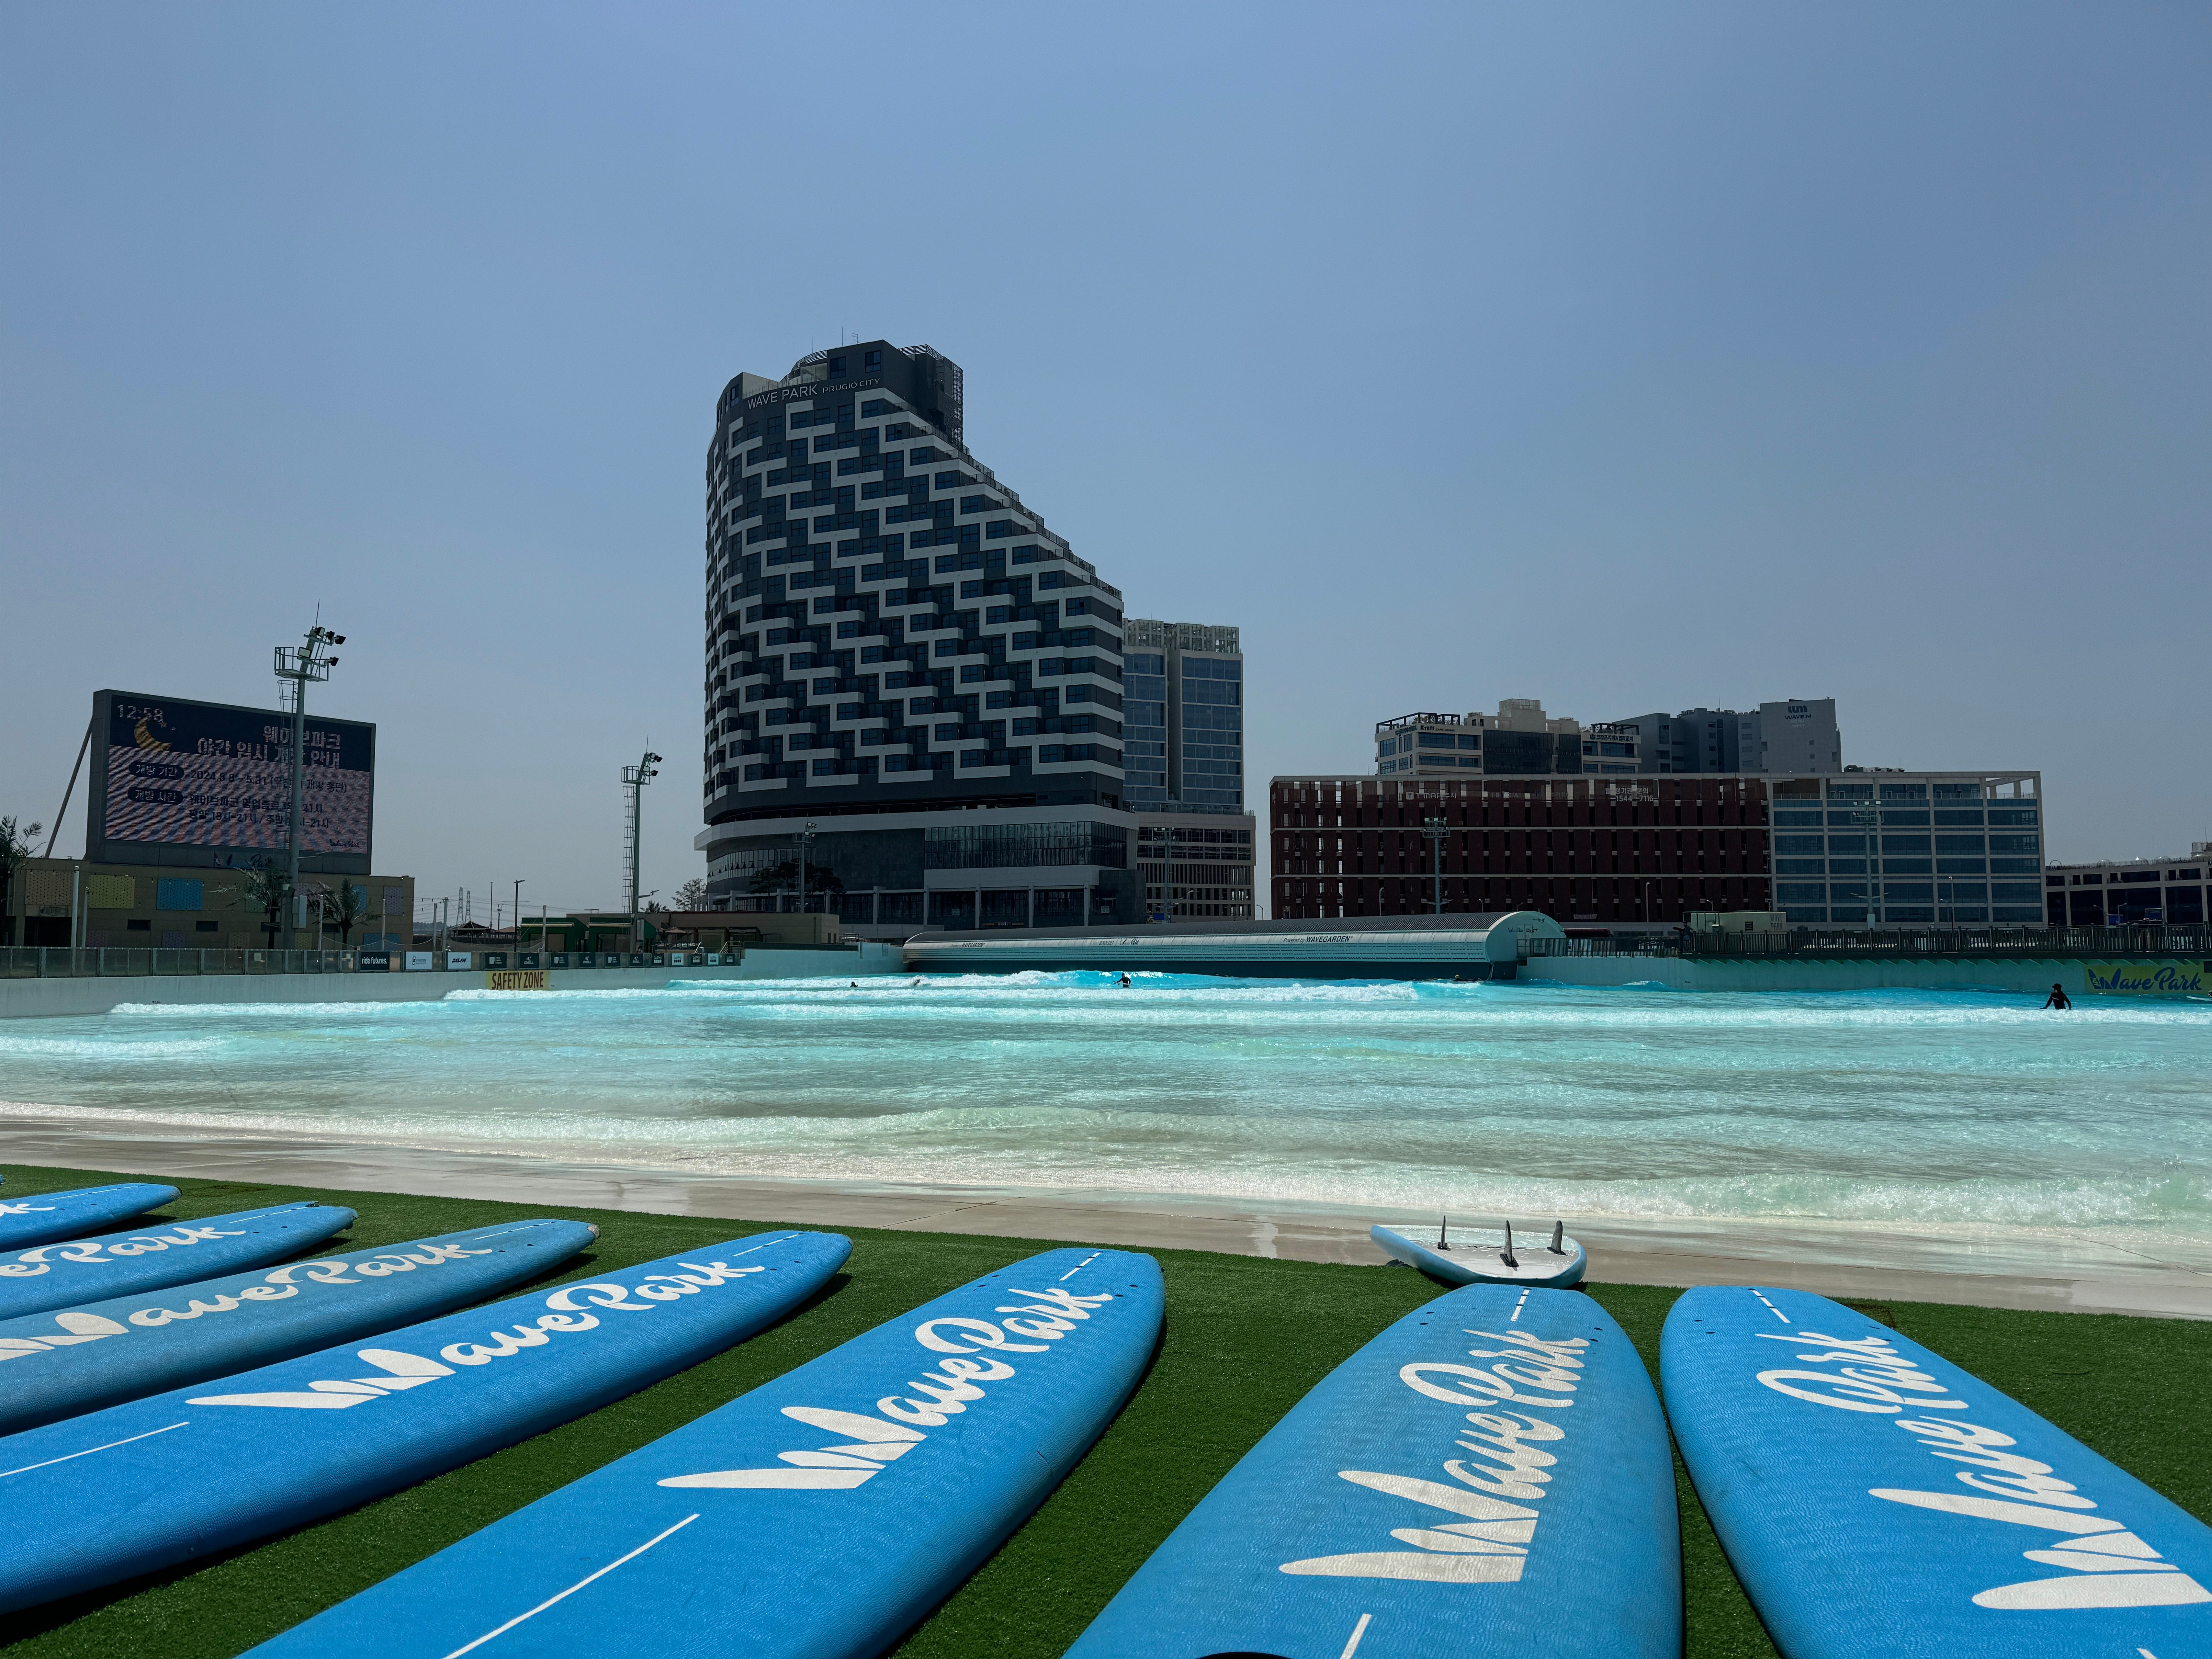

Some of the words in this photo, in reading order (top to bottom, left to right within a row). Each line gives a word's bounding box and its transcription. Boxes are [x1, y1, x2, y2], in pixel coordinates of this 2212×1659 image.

[747, 392, 778, 410] WAVE
[781, 384, 818, 400] PARK
[822, 382, 857, 393] PRUGIO
[859, 378, 881, 386] CITY
[117, 705, 163, 722] 12:58
[197, 738, 232, 757] 야간
[237, 742, 268, 761] 임시
[274, 746, 306, 766] 개
[311, 750, 340, 769] 안내
[136, 764, 155, 776] 개방
[158, 767, 177, 777] 기간
[191, 770, 235, 782] 2024.5.8
[135, 790, 155, 800] 개방
[157, 792, 177, 802] 시간
[190, 795, 239, 807] 웨이브파크
[302, 804, 322, 813] 21시
[492, 972, 522, 990] SAFETY
[524, 972, 544, 988] ZONE
[2088, 968, 2154, 990] Wave
[2154, 967, 2202, 991] Park
[18, 1227, 246, 1262] Park
[265, 1244, 492, 1284] Park
[185, 1312, 599, 1409] Wave
[546, 1262, 765, 1311] Park
[1399, 1329, 1590, 1408] Park
[1754, 1332, 1969, 1413] Park
[656, 1356, 1015, 1489] Wave
[915, 1288, 1113, 1353] Park
[1278, 1410, 1565, 1583] Wave
[1868, 1415, 2212, 1610] Wave
